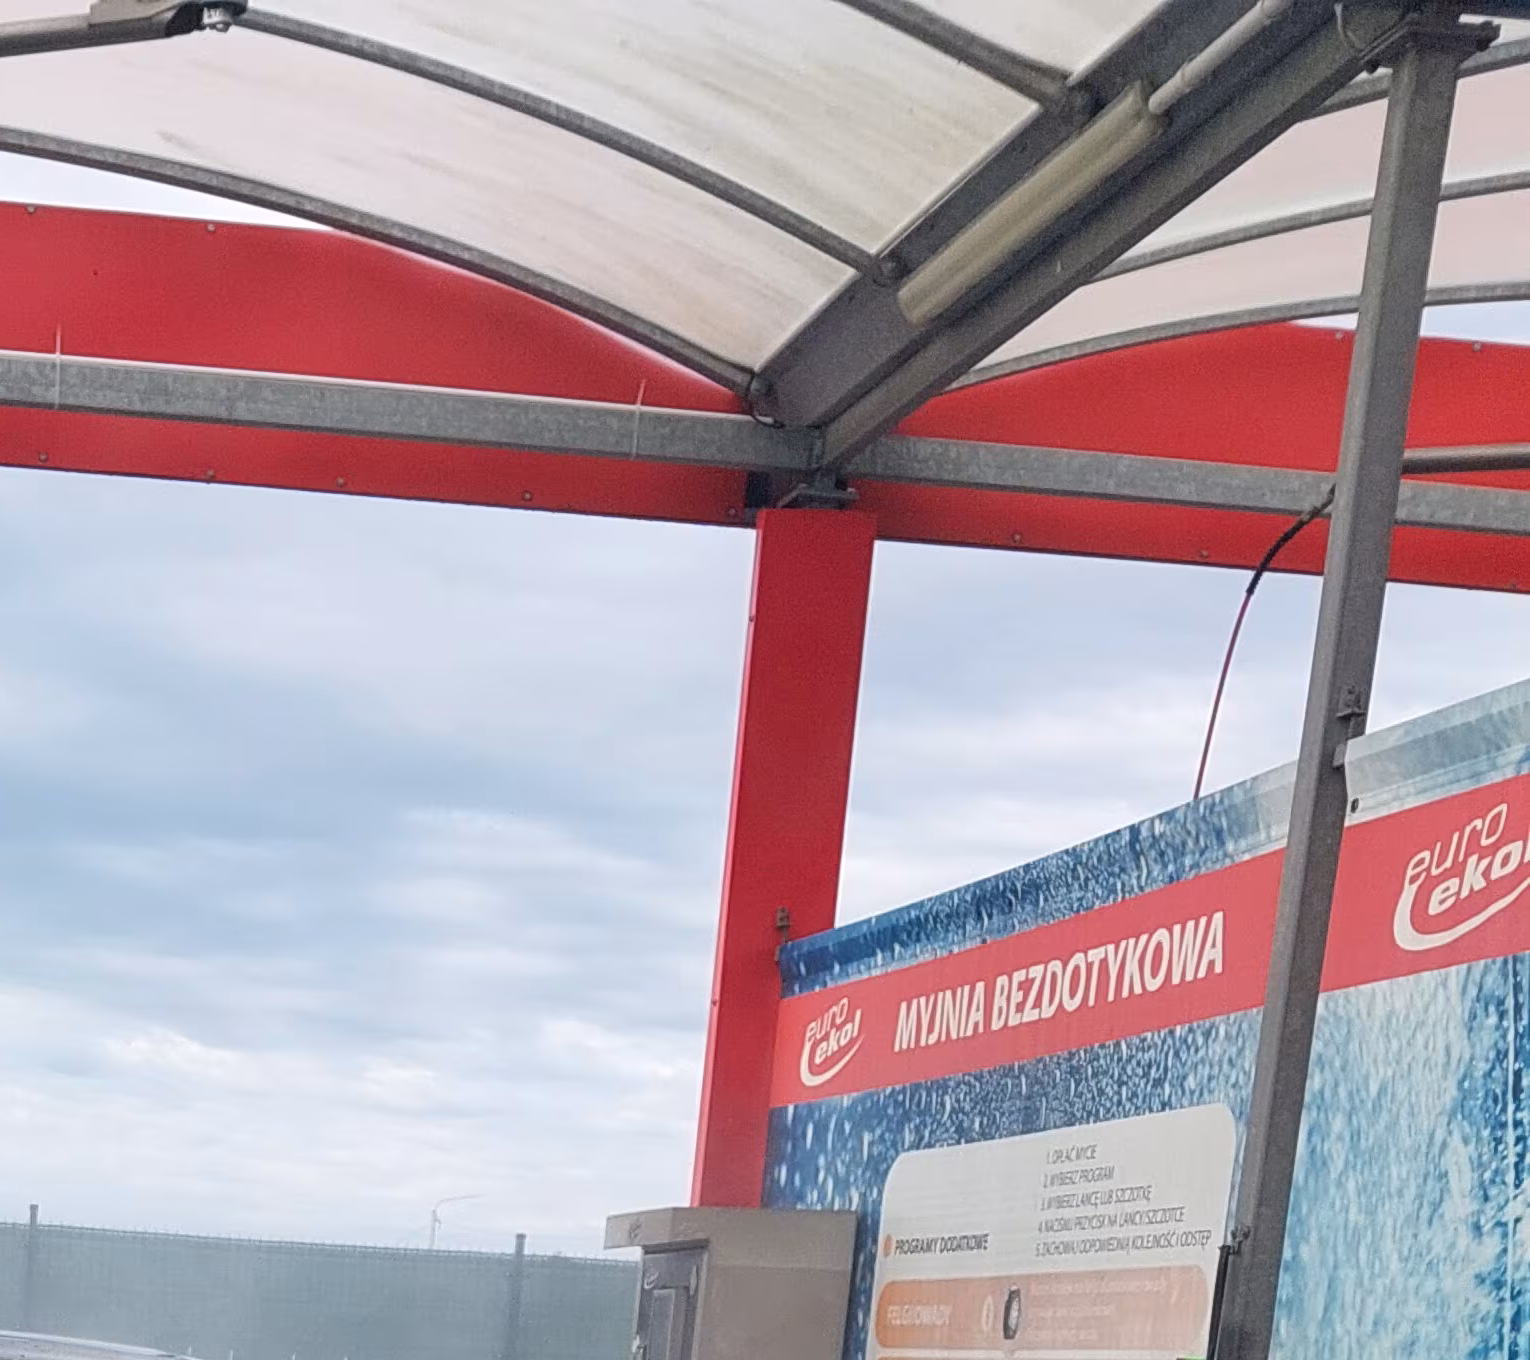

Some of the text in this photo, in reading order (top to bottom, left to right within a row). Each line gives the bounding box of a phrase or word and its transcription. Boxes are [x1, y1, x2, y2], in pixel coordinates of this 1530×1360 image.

[1407, 803, 1508, 887] euro
[893, 910, 1224, 1053] MYJNIA BEZDOTYKOWA
[805, 997, 849, 1043] euro
[814, 1009, 862, 1065] ekol
[895, 1238, 937, 1255] PROGRAMY
